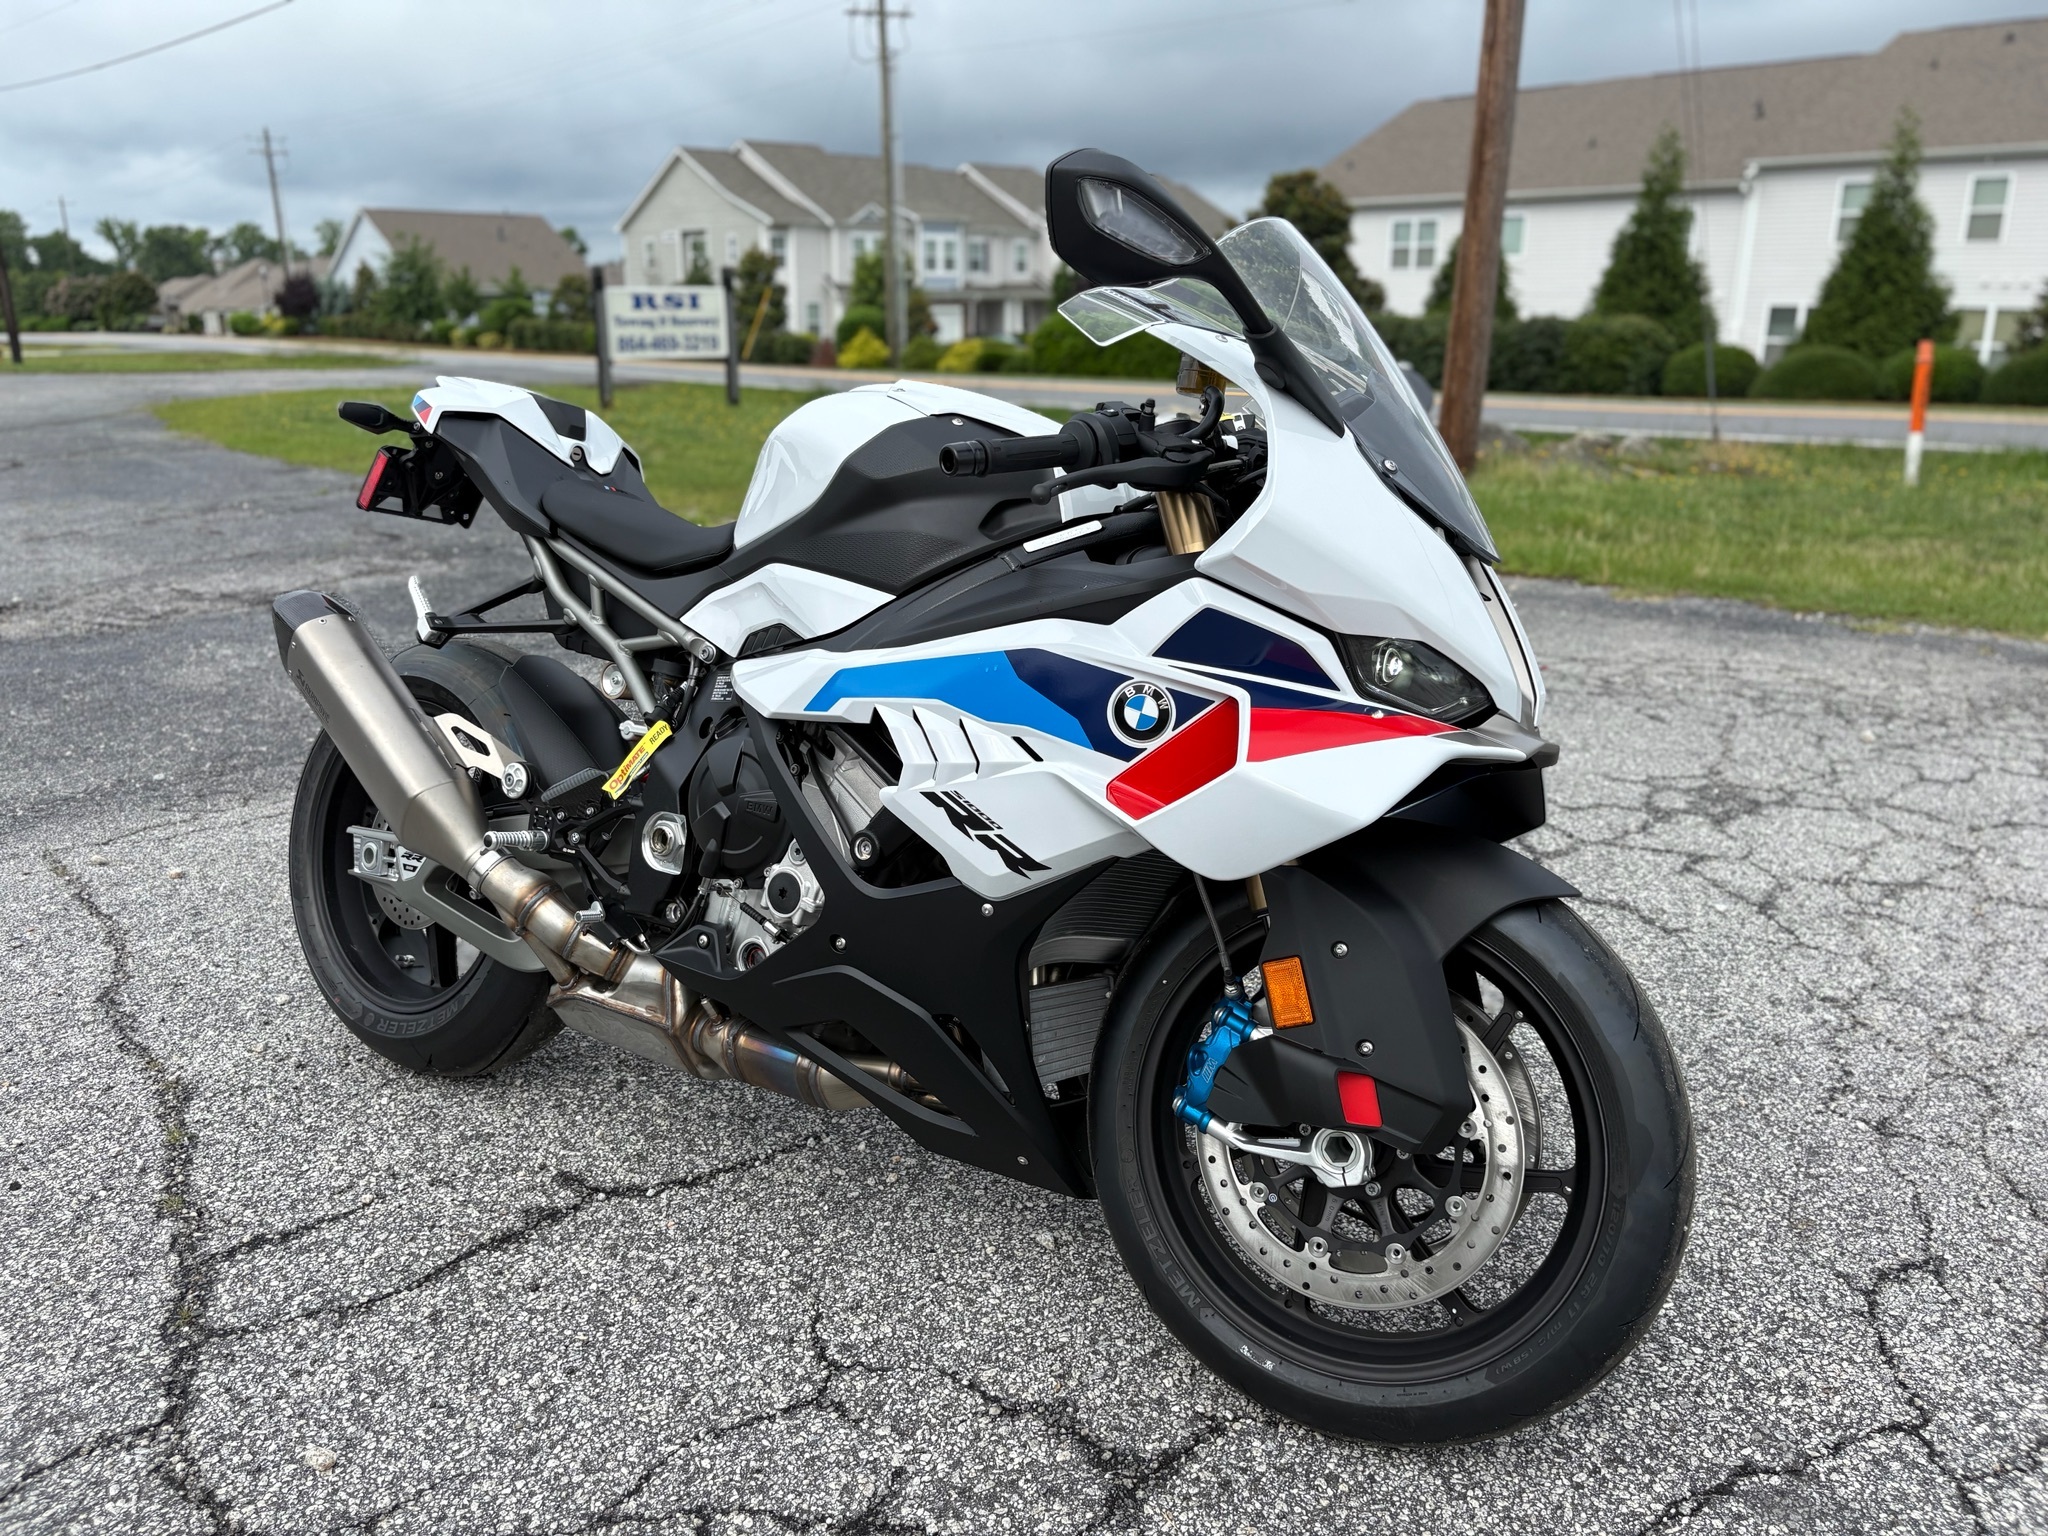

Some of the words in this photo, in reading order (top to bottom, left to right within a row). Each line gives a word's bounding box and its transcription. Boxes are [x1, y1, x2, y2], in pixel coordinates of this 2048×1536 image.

[632, 293, 700, 310] RSI
[1123, 684, 1169, 710] BMW
[649, 724, 668, 745] READY
[609, 744, 646, 790] OptiMATE
[745, 801, 774, 815] BMW
[950, 790, 1004, 831] S1000
[918, 790, 1053, 880] RR
[376, 1002, 459, 1035] METZELER
[1126, 1174, 1201, 1310] METZELER
